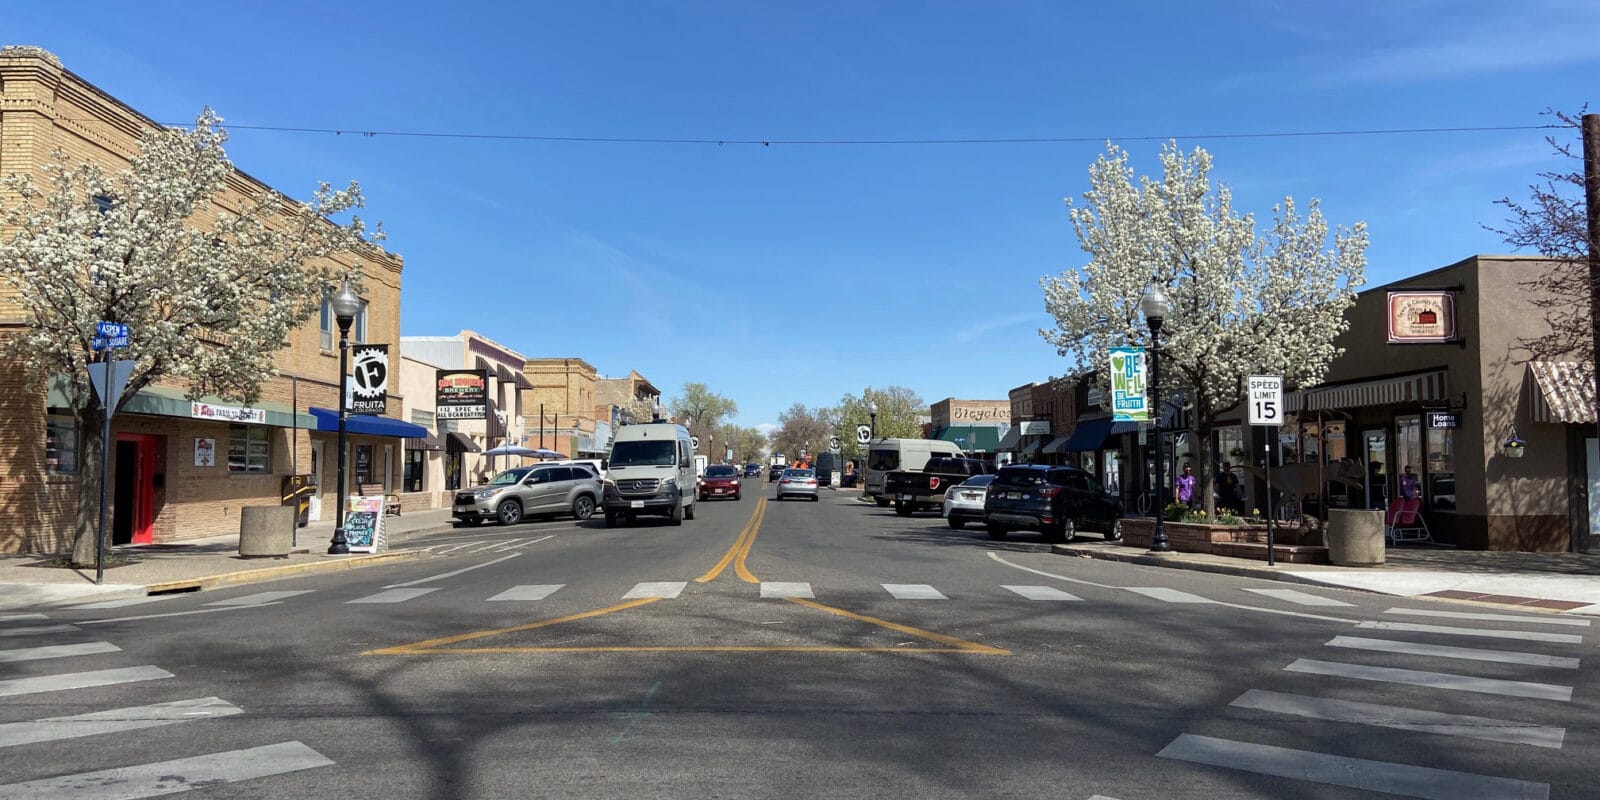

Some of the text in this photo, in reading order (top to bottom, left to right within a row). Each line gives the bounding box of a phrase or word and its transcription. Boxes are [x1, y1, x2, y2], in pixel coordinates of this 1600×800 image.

[102, 324, 120, 336] ASPEN
[1125, 355, 1141, 378] BE
[1114, 372, 1144, 396] WELL
[1250, 381, 1279, 390] SPEED
[1254, 391, 1276, 399] LIMIT
[353, 400, 385, 409] FRUITA
[1117, 400, 1141, 409] FRUITA
[953, 407, 1014, 421] Bicycles
[1255, 401, 1276, 419] 15
[1432, 420, 1456, 428] Loans
